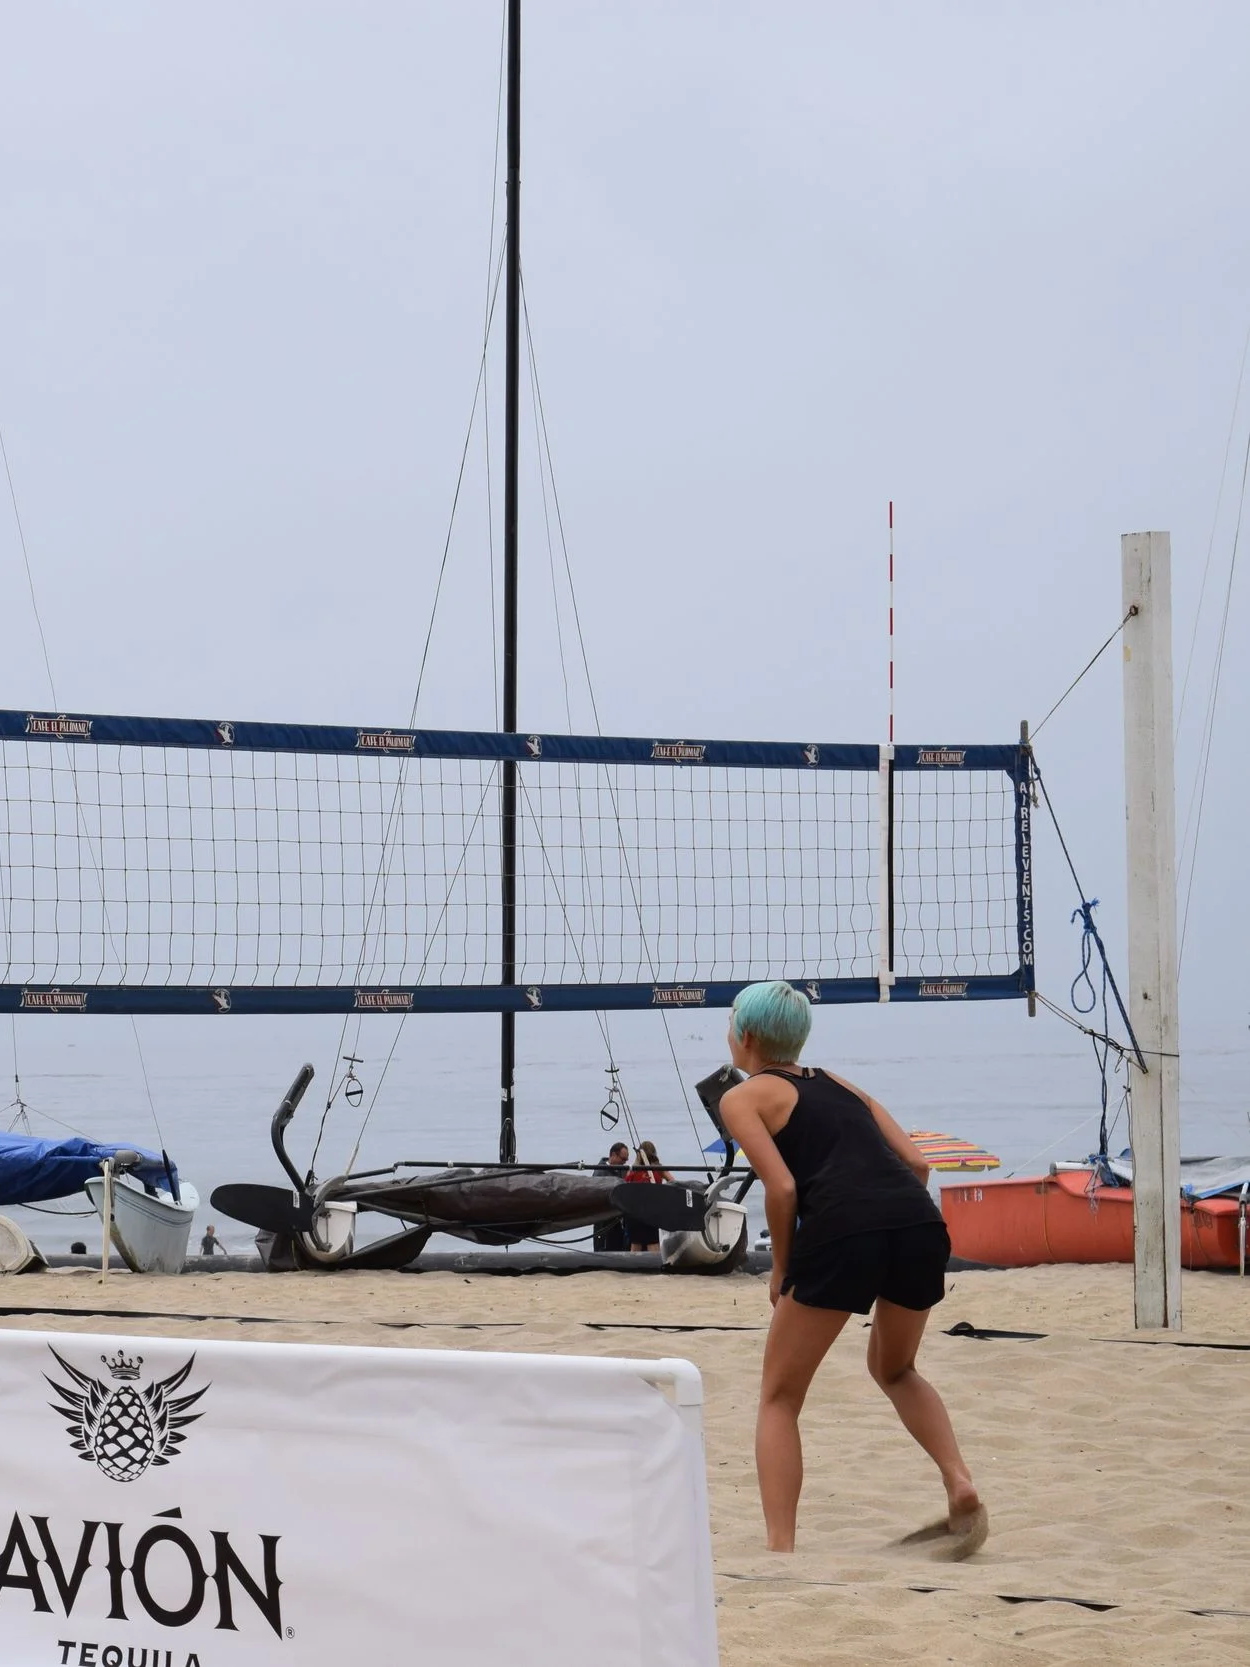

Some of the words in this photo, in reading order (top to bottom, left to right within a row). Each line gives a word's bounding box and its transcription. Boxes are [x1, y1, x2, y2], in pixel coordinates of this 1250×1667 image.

[34, 721, 49, 731] CAFE
[52, 721, 59, 732] EL
[60, 722, 86, 732] PALOMAR
[362, 736, 377, 746] CAFE
[1019, 781, 1034, 966] AIRELEVENTS.COM
[28, 994, 44, 1004] CAFE
[46, 994, 53, 1004] EL
[54, 994, 81, 1005] PALOMAR
[361, 995, 376, 1005] CAFE
